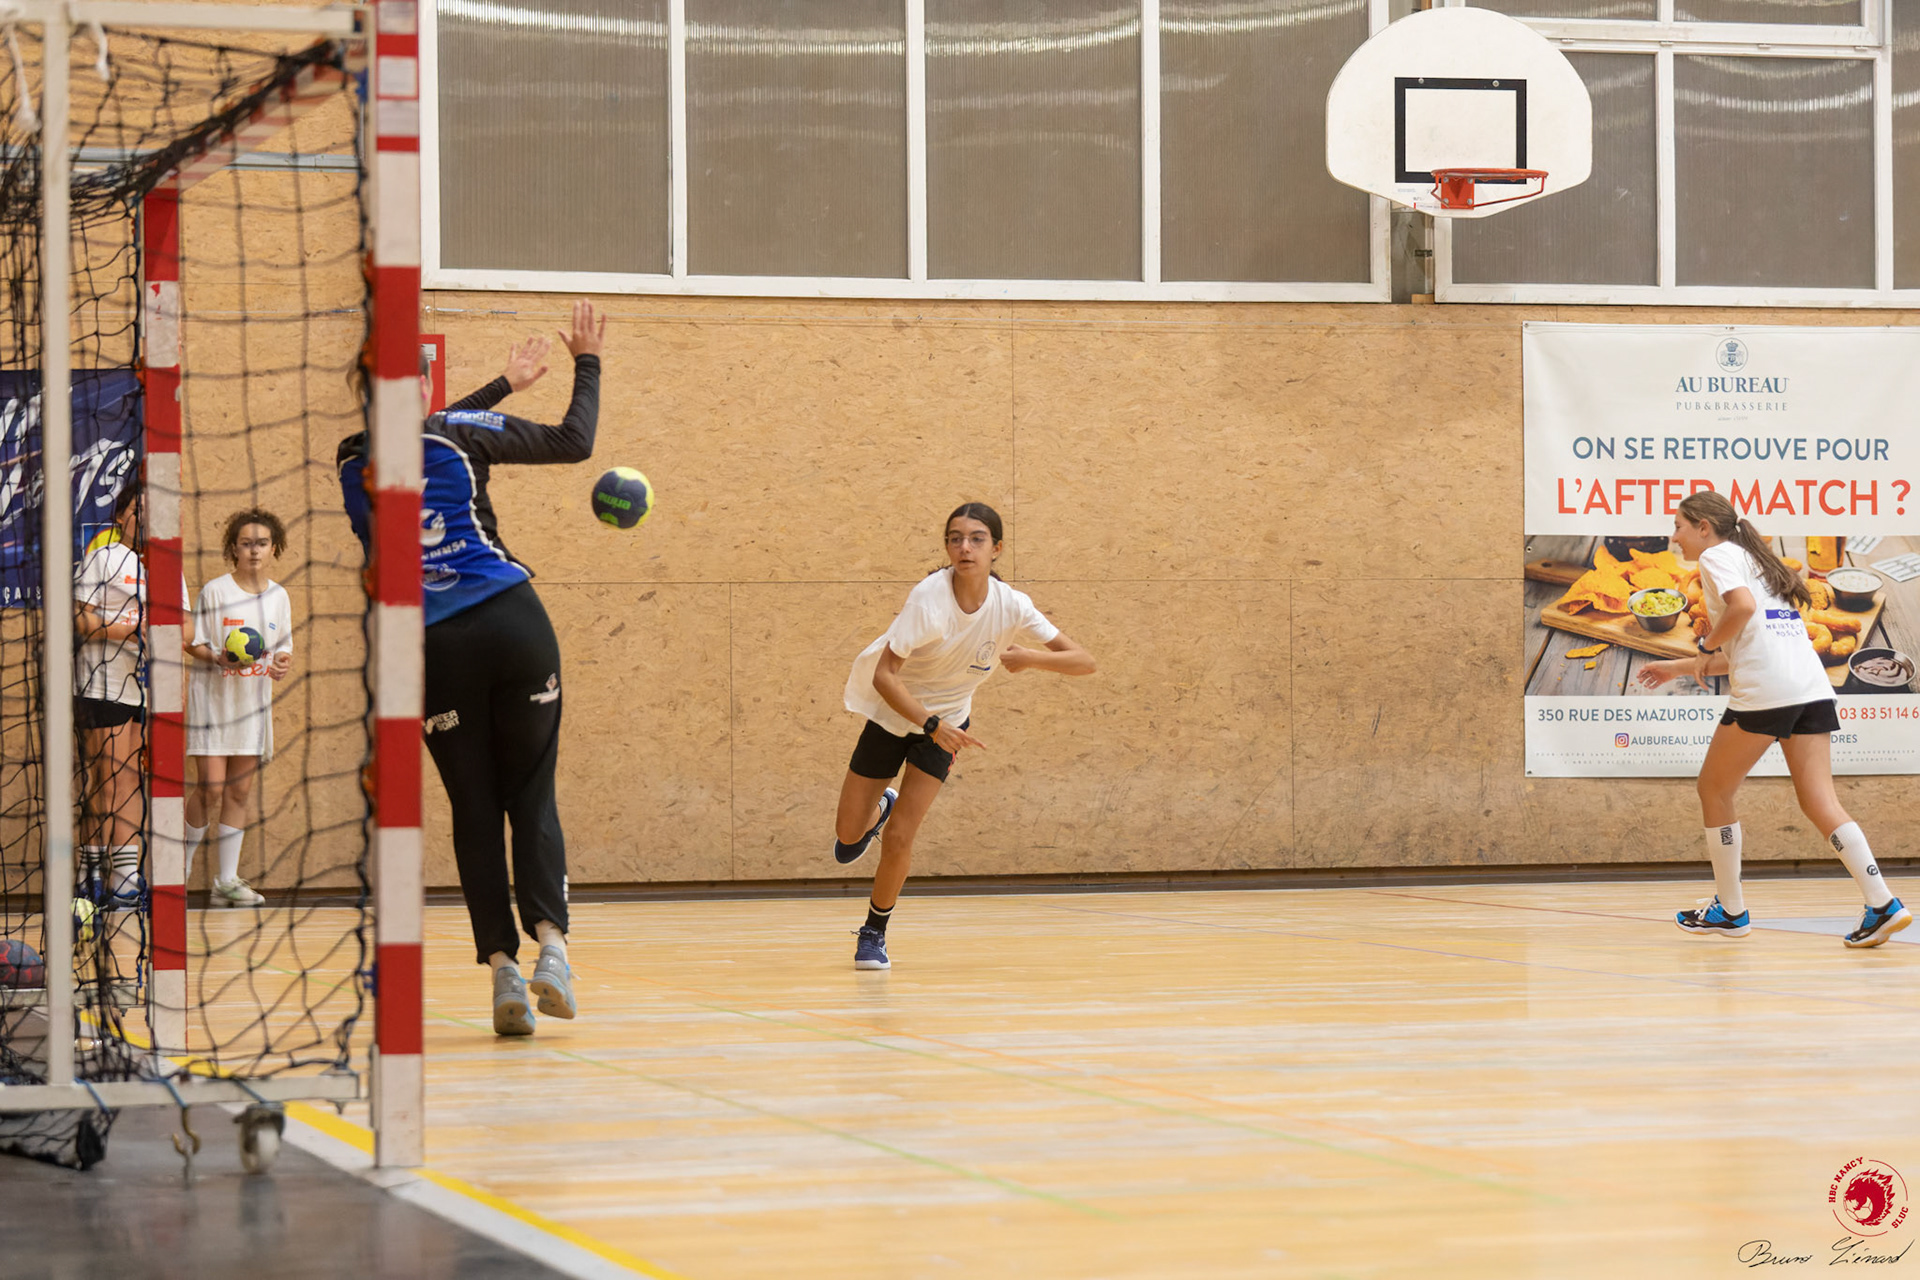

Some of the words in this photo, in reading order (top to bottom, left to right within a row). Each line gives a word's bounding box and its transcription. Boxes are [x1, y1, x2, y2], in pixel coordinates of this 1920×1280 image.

[1675, 376, 1703, 393] AU
[1707, 376, 1790, 393] BUREAU
[1572, 436, 1615, 460] ON
[1624, 437, 1655, 460] SE
[1664, 437, 1807, 460] RETROUVE
[1816, 438, 1889, 461] POUR
[1729, 479, 1878, 516] MATCH
[1890, 479, 1911, 516] ?
[1538, 708, 1564, 721] 350
[1568, 708, 1600, 721] RUE
[1604, 708, 1632, 721] DES
[1636, 708, 1714, 721] MAZUROTS
[1839, 707, 1857, 719] 03
[1860, 707, 1877, 719] 83
[1879, 707, 1892, 719] 51
[1895, 706, 1908, 719] 14
